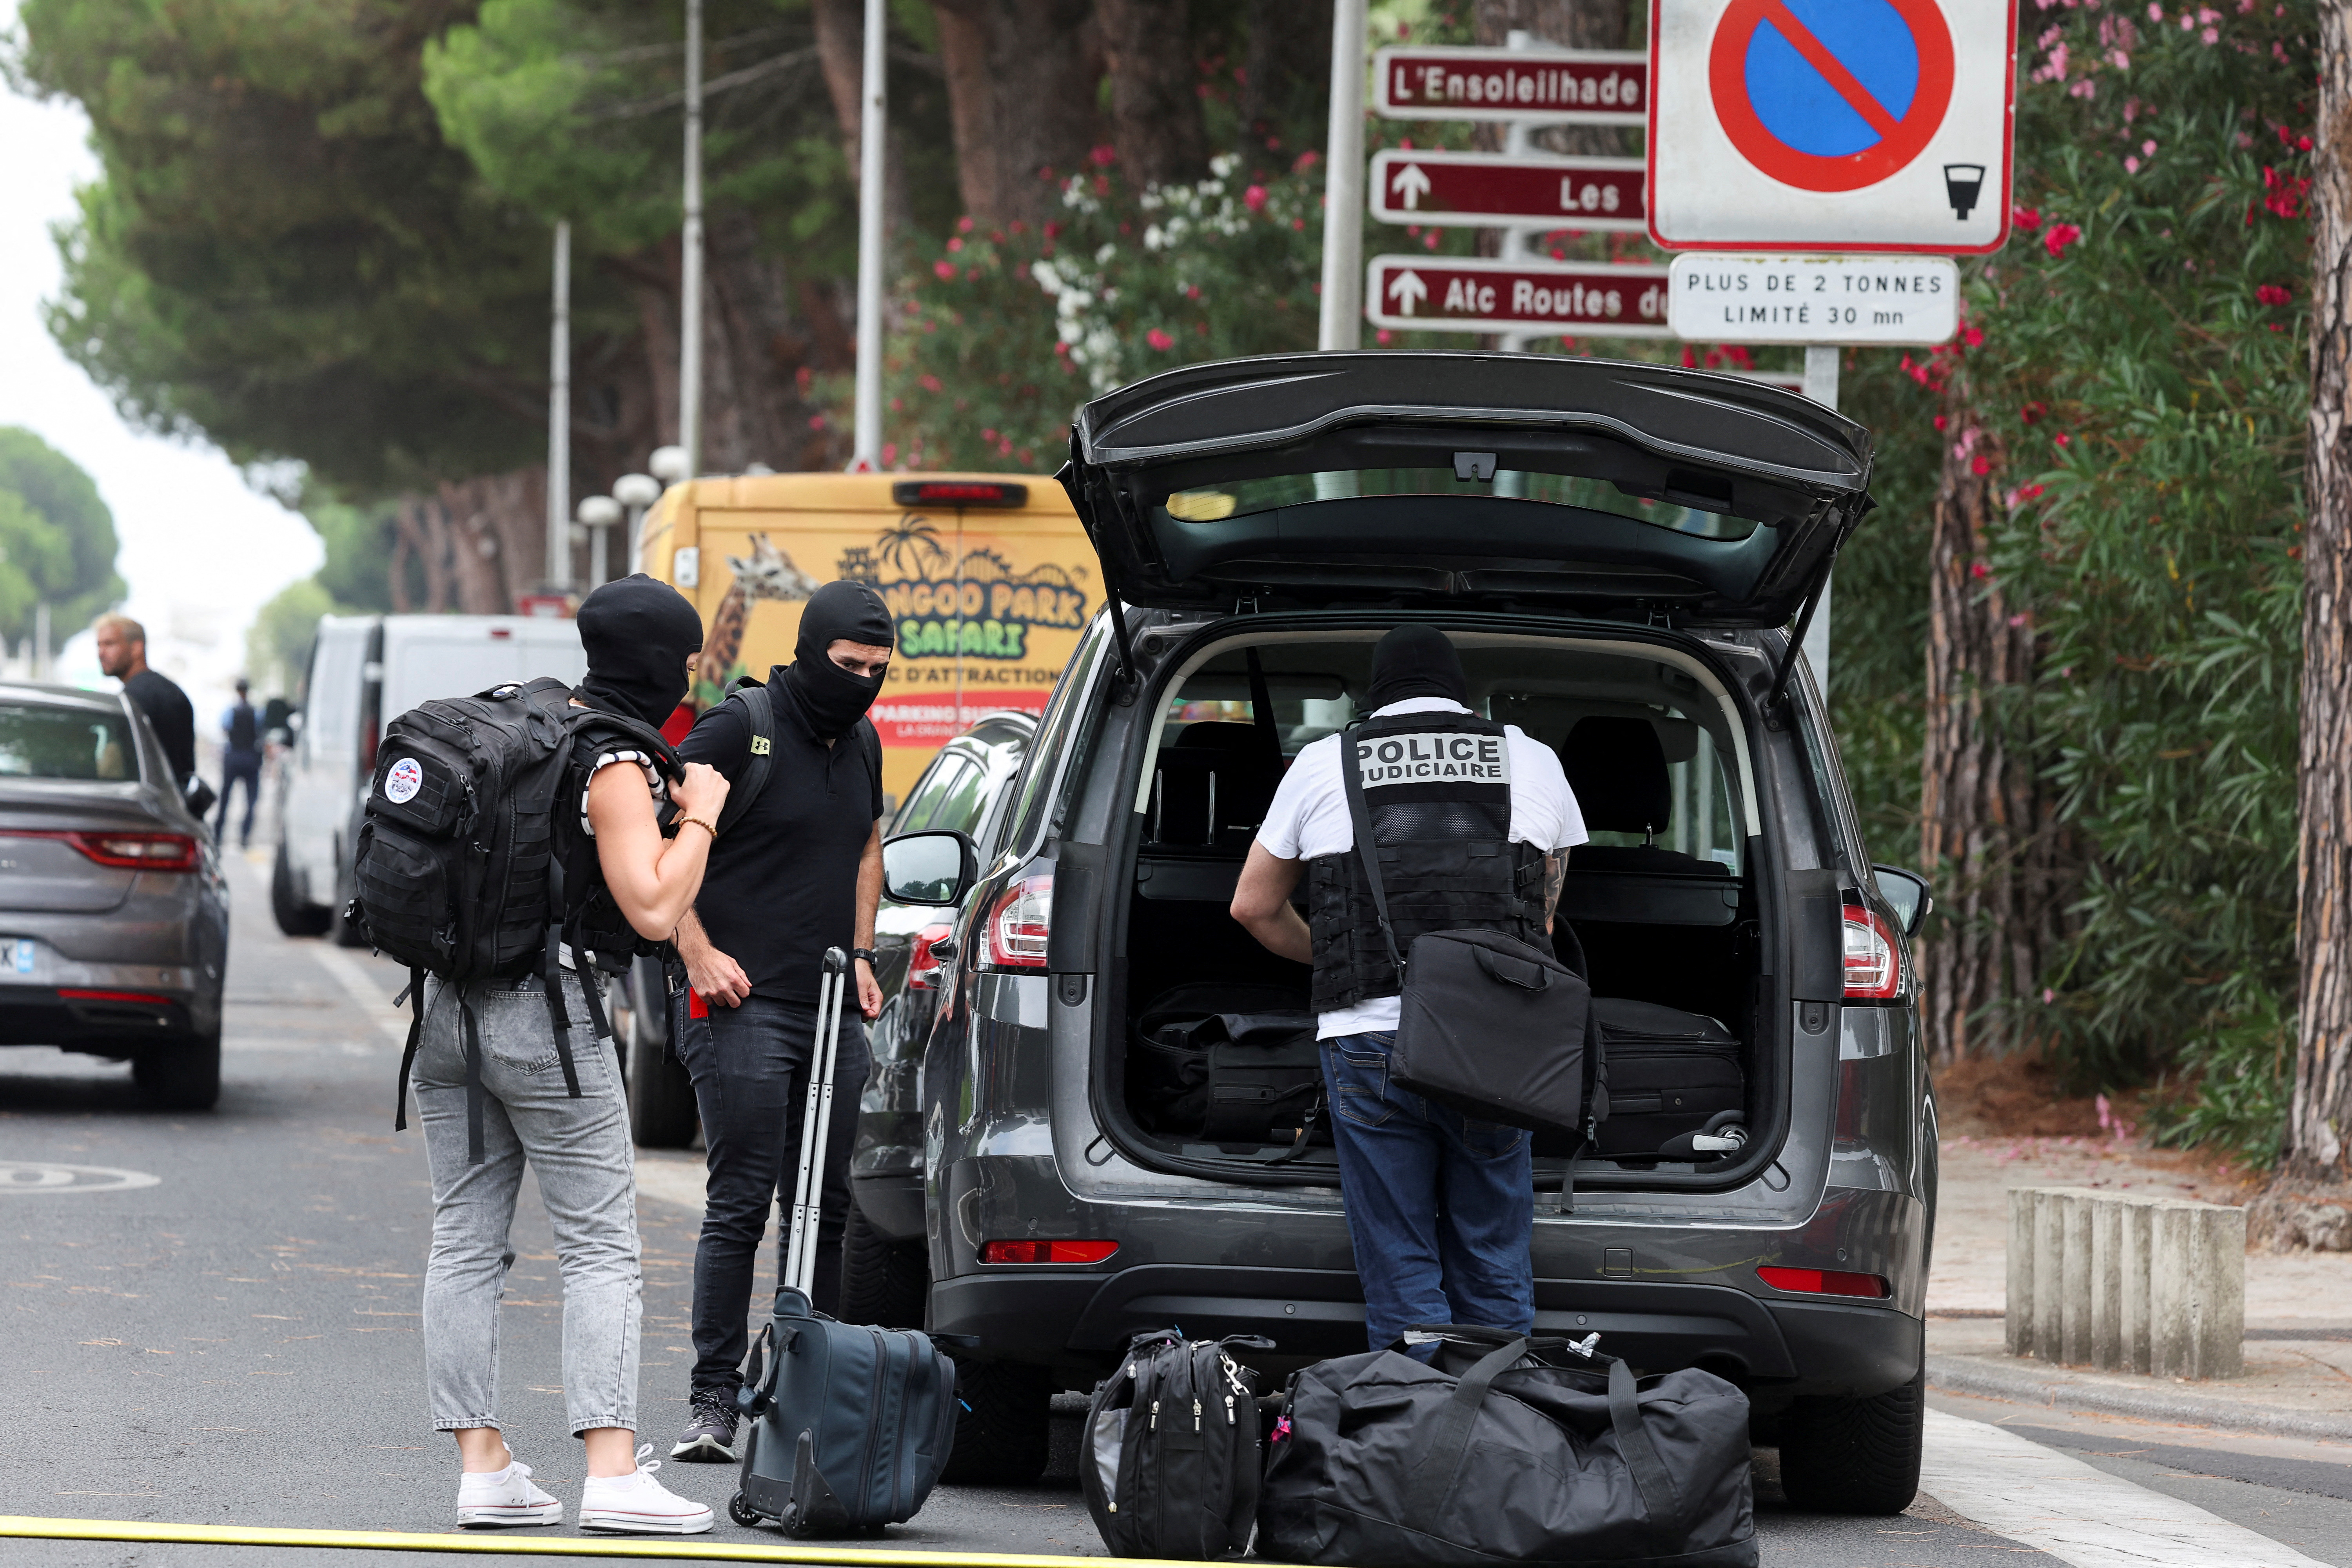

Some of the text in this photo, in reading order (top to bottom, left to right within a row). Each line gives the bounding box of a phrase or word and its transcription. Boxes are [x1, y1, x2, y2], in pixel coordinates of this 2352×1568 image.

[1395, 65, 1639, 106] L'Ensoleilhade
[1560, 176, 1620, 212] Les
[1444, 277, 1497, 313] Atc
[1512, 279, 1622, 317] Routes
[1688, 274, 1942, 293] PLUS DE 2 TONNES
[1724, 302, 1904, 325] LIMITÉ 30 mn
[991, 583, 1082, 626] PARK
[902, 619, 1024, 656] SAFARI
[1357, 738, 1500, 763] POLICE
